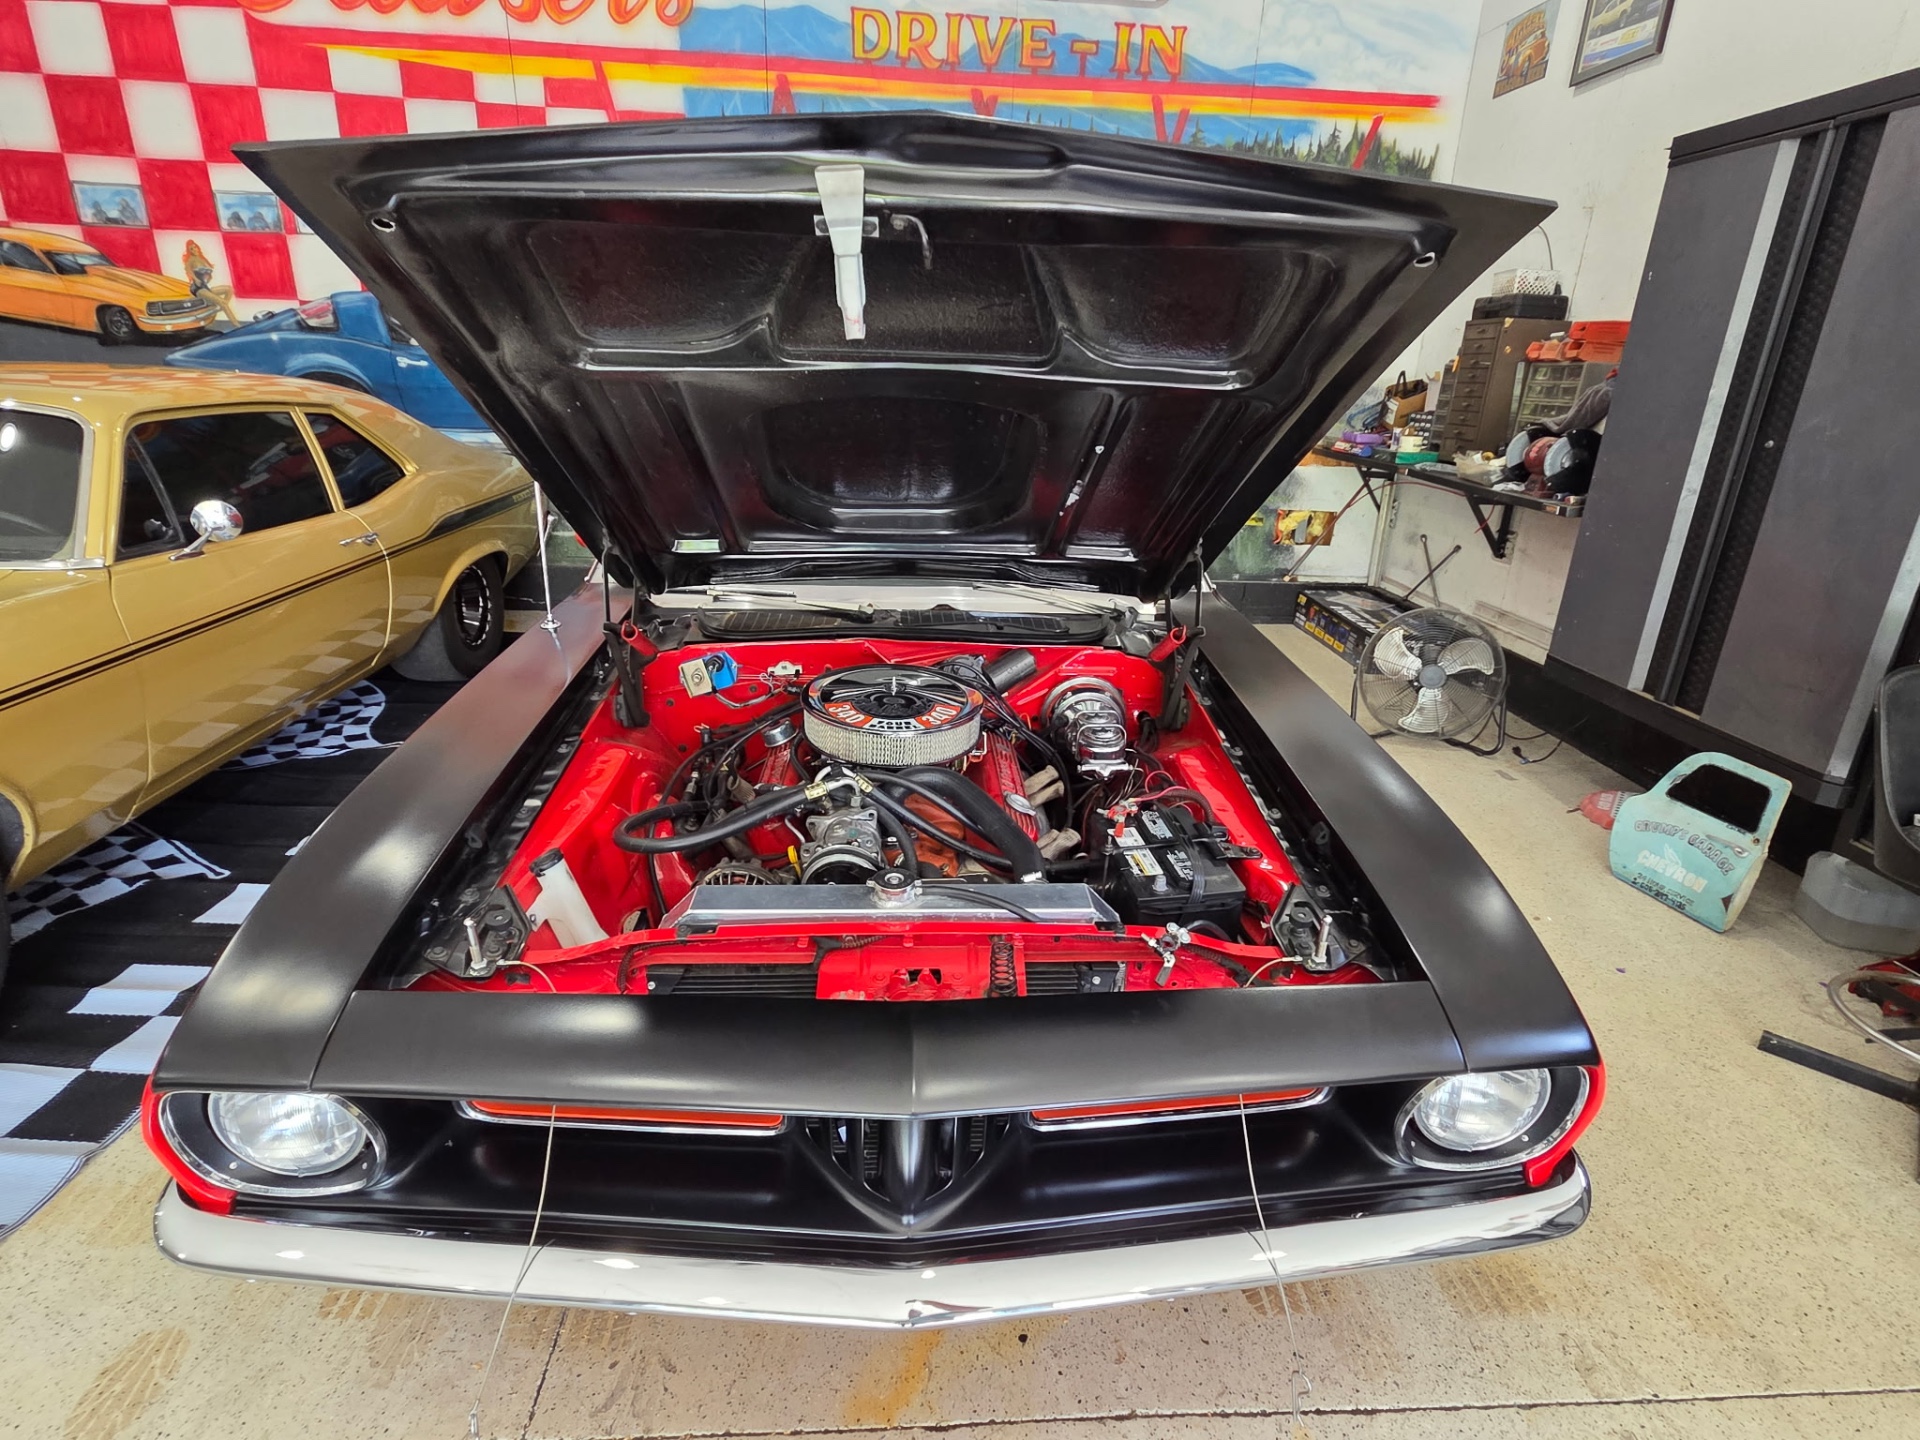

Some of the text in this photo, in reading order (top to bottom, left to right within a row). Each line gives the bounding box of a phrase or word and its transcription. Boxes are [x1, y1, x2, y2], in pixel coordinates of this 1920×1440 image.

[850, 6, 1188, 76] DRIVE-IN
[828, 704, 865, 725] 340
[922, 705, 957, 725] 340
[1634, 820, 1735, 876] GRUMP'S GARAGE
[1636, 849, 1708, 894] CHEVRON
